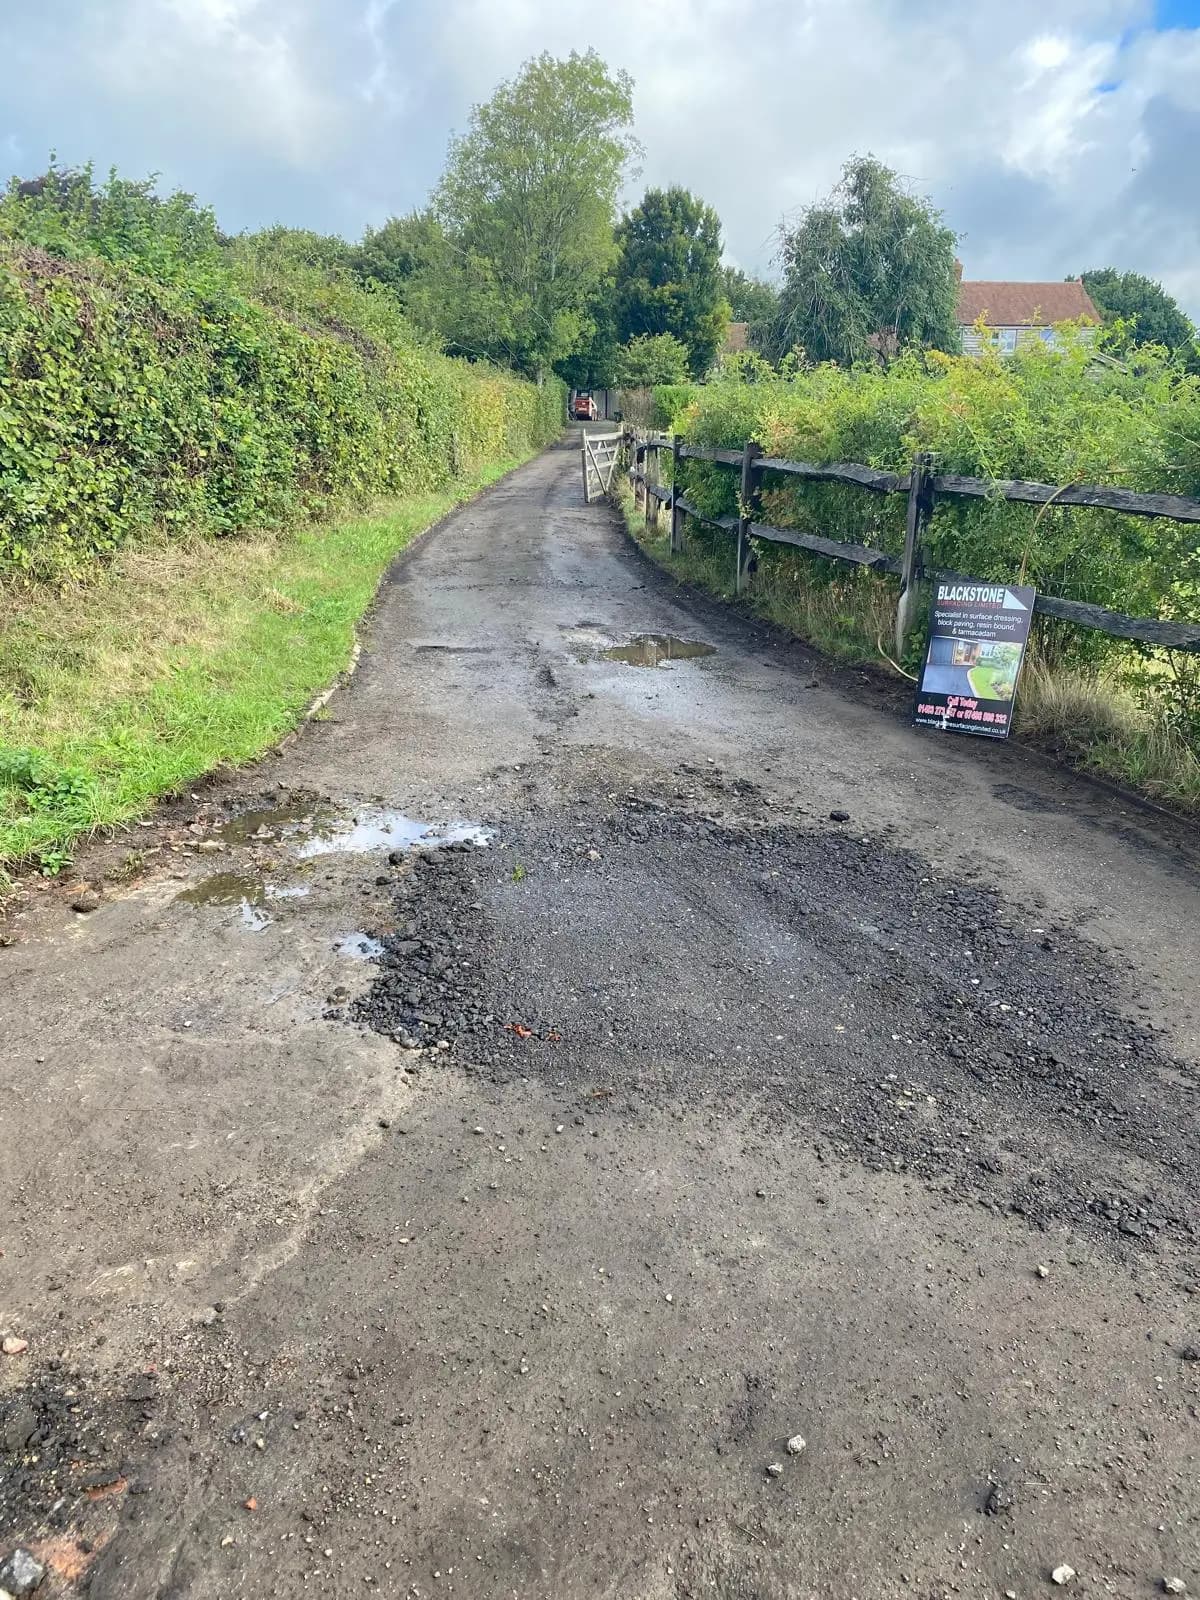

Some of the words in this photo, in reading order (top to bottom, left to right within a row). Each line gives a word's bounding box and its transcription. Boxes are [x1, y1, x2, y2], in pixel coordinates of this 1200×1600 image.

[938, 586, 1004, 603] BLACKSTONE
[934, 610, 962, 619] Specialist
[969, 613, 993, 621] surface
[993, 615, 1023, 624] dressing,
[951, 627, 957, 635] &
[957, 628, 996, 638] tarmacadam
[993, 622, 1016, 631] bound,
[947, 696, 959, 706] Call
[959, 697, 978, 711] Today
[956, 710, 964, 719] or
